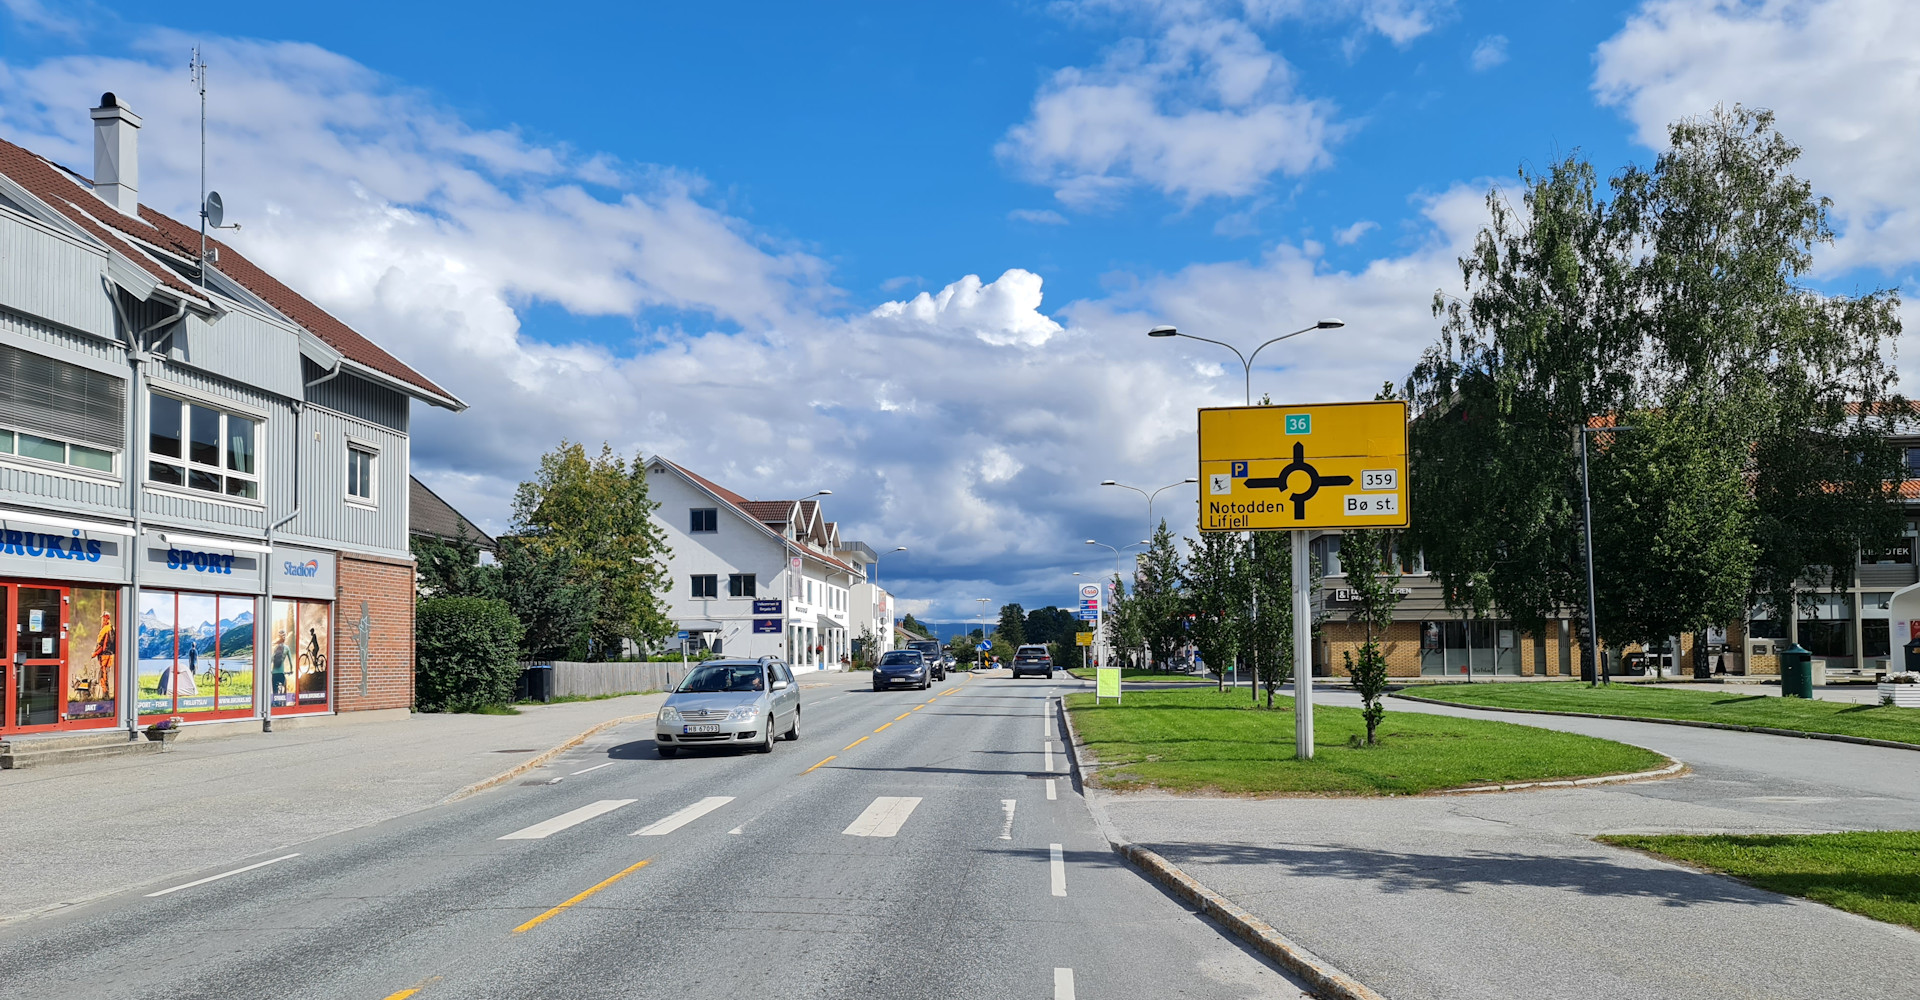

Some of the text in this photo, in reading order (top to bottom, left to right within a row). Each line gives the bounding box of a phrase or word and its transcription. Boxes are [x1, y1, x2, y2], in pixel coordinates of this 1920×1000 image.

[1289, 418, 1307, 430] 36
[1234, 463, 1245, 477] P
[1366, 473, 1392, 486] 359
[1209, 500, 1285, 514] Notodden
[1347, 497, 1395, 511] Bø st.
[1209, 514, 1249, 530] Lifjell
[0, 528, 102, 563] RUKÅS
[1861, 547, 1910, 556] IOTEK
[166, 548, 235, 575] SPORT
[283, 560, 318, 578] Stadion
[84, 703, 97, 712] JAKT
[155, 700, 168, 708] FISKE
